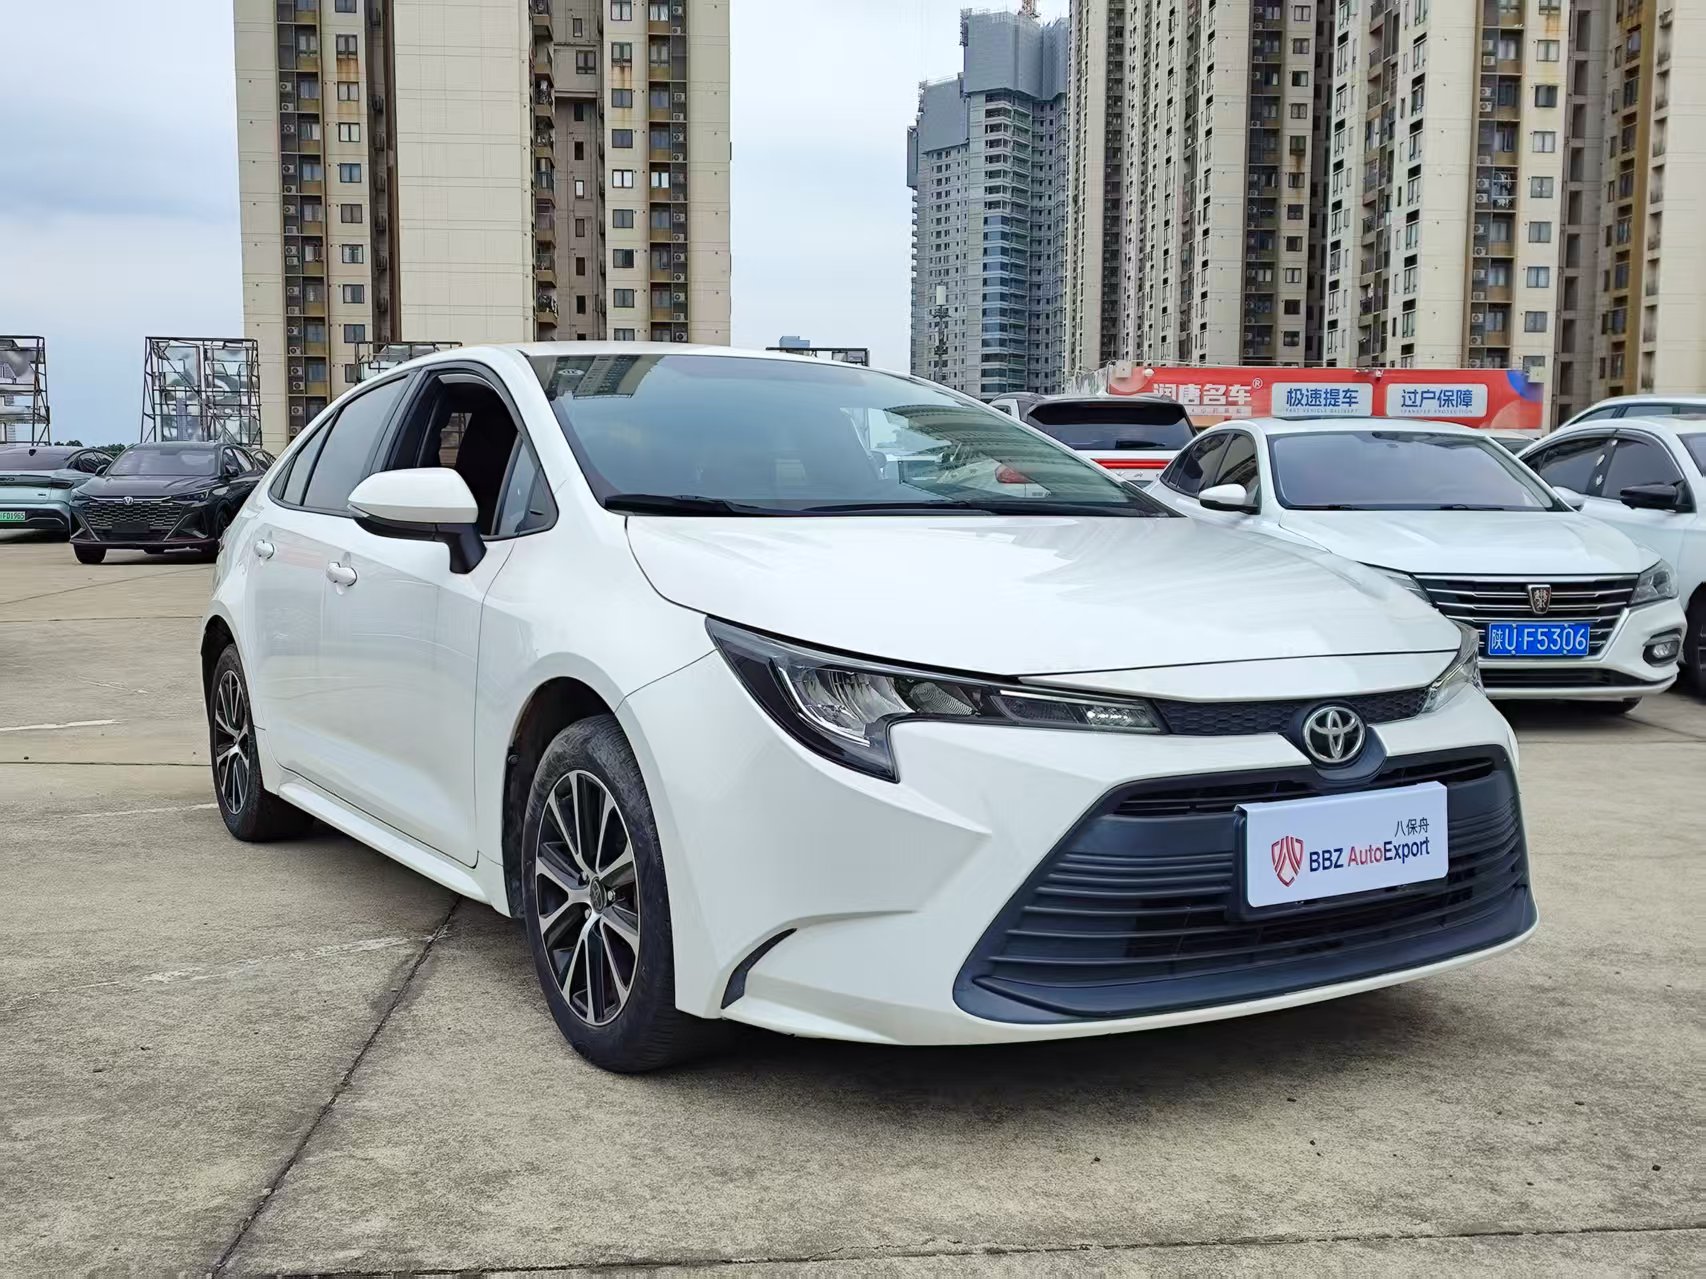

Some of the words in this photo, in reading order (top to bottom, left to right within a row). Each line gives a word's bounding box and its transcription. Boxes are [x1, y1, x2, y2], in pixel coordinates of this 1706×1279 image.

[1286, 388, 1359, 408] 极速提车
[1401, 389, 1473, 408] 过户保障
[1394, 817, 1429, 837] 八保舟
[1309, 847, 1344, 872] BBZ
[1348, 836, 1430, 867] AutoExport
